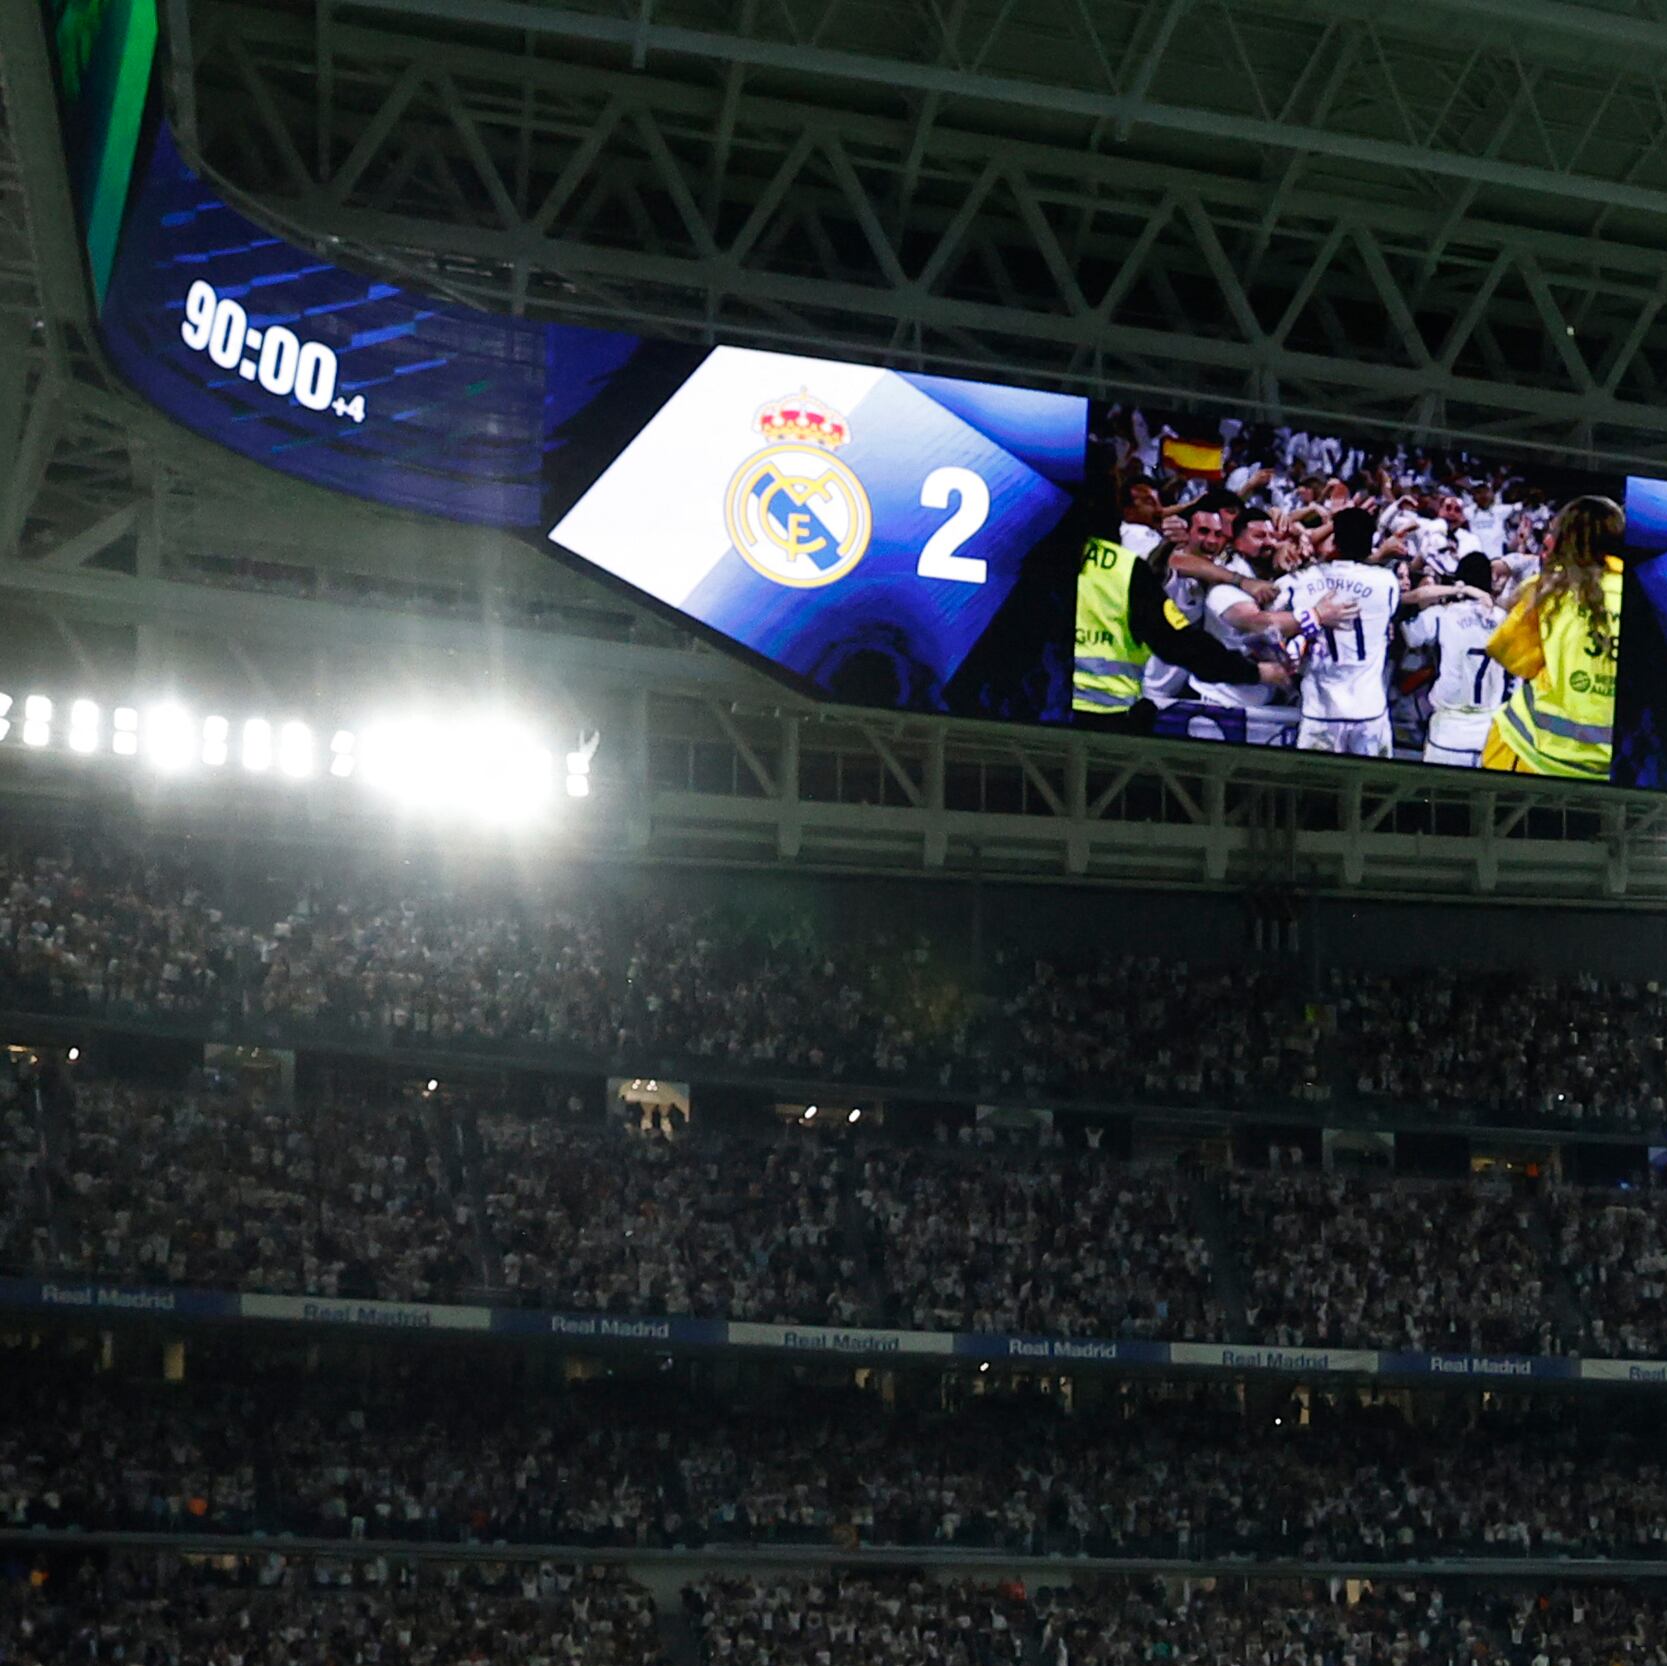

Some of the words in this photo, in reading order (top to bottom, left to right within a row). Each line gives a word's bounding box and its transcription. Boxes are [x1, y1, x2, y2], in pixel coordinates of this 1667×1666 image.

[181, 280, 338, 412] 90:00
[333, 394, 366, 423] +4
[916, 467, 989, 584] 2
[1466, 647, 1492, 704] 7
[42, 1285, 91, 1307] Real
[97, 1288, 175, 1310] Madrid
[304, 1303, 351, 1322] Real
[358, 1306, 431, 1327] Madrid
[552, 1315, 596, 1334] Real
[601, 1319, 669, 1338] Madrid
[784, 1331, 827, 1348] Real
[833, 1334, 900, 1351] Madrid
[1009, 1339, 1048, 1356] Real
[1054, 1341, 1117, 1358] Madrid
[1222, 1350, 1261, 1367] Real
[1266, 1352, 1328, 1369] Madrid
[1431, 1357, 1467, 1373] Real
[1472, 1358, 1531, 1375] Madrid
[1629, 1366, 1666, 1382] Real
